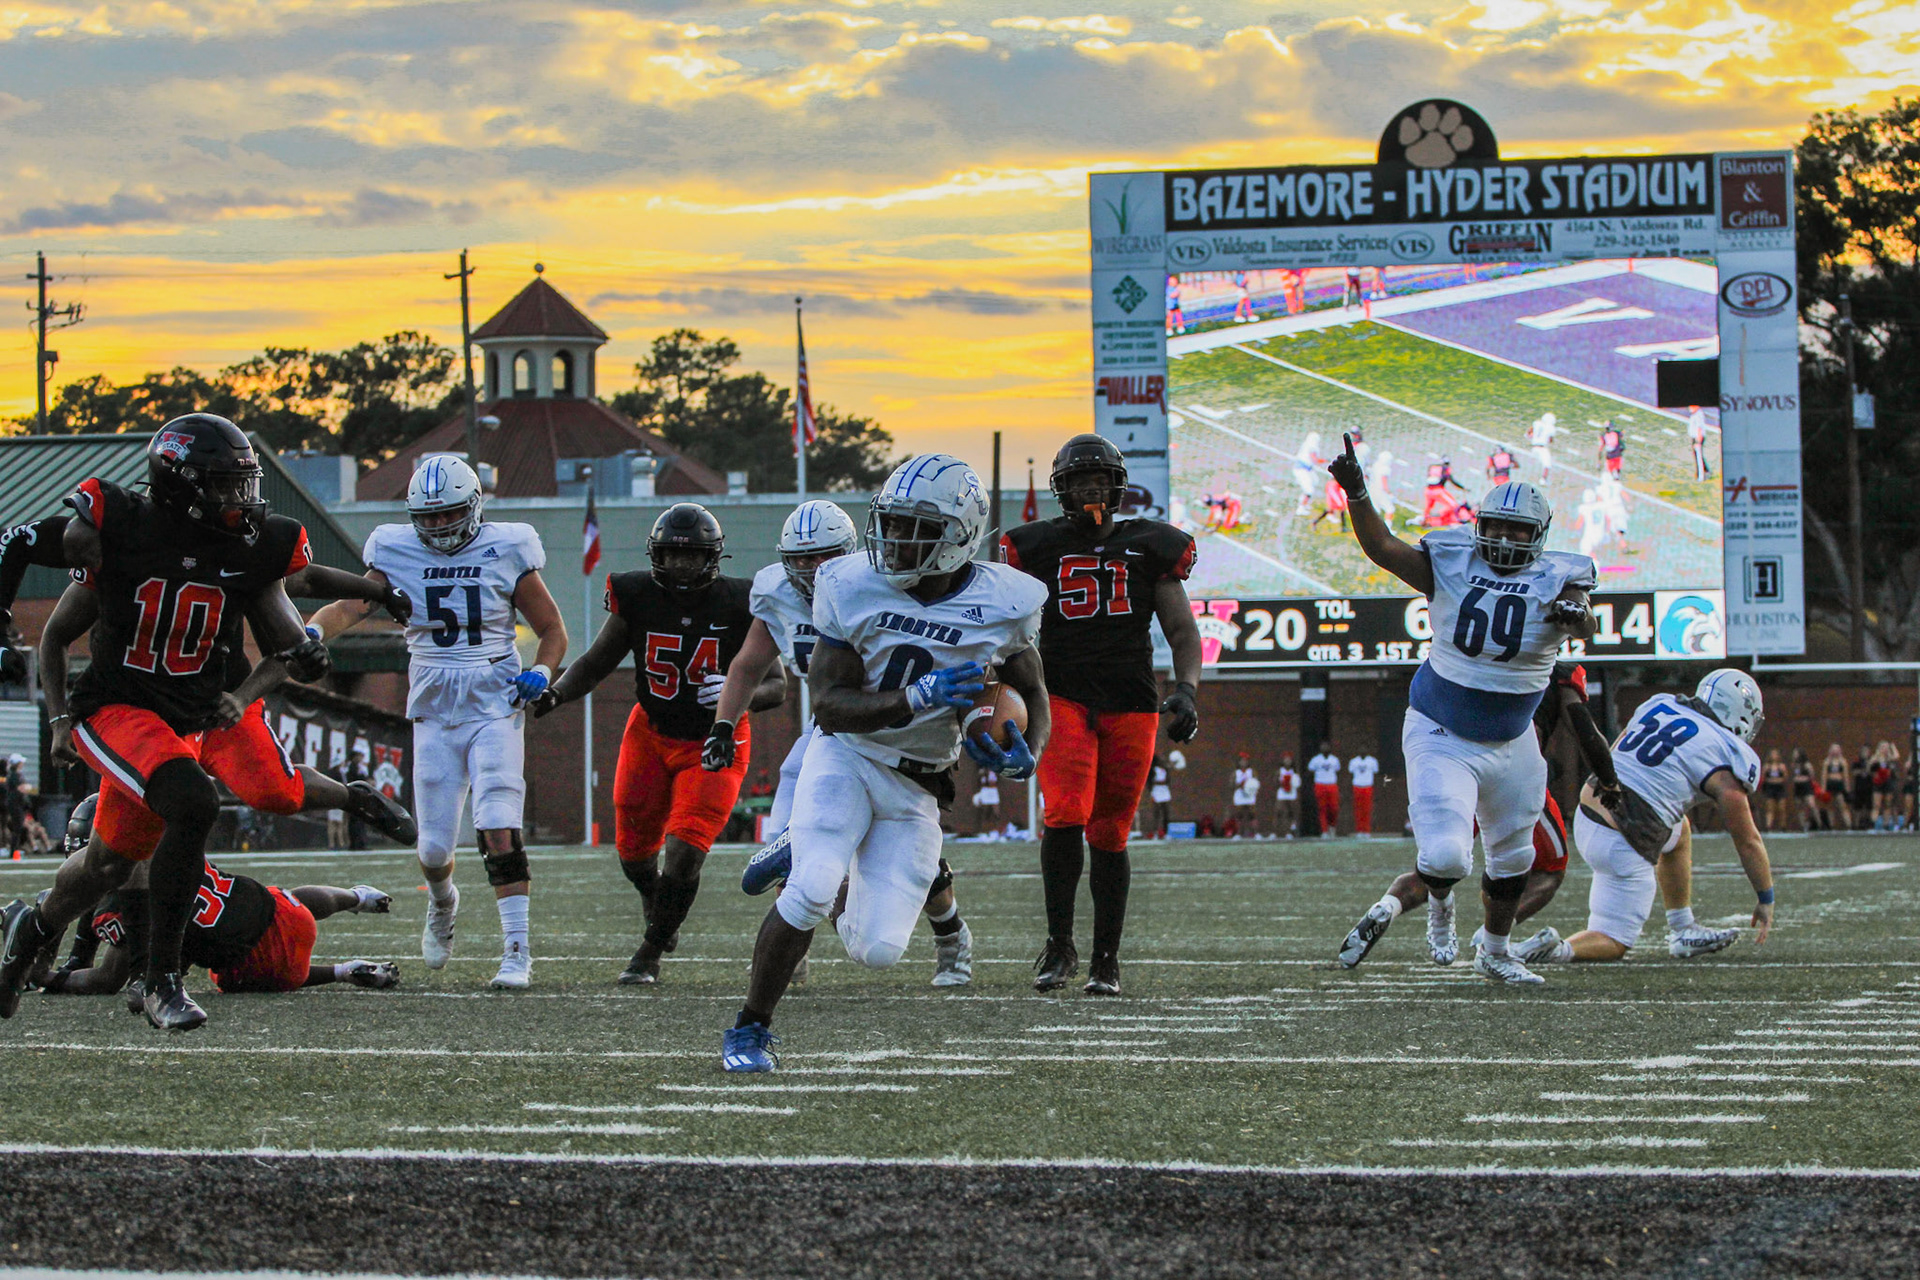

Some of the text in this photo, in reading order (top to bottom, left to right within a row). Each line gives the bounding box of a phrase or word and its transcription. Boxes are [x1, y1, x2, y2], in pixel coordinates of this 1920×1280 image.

[1722, 159, 1784, 175] Blanton
[1172, 171, 1374, 225] BAZEMORE
[1406, 166, 1531, 218] HYDER
[1541, 160, 1706, 213] STADIUM
[1743, 180, 1763, 203] &
[1565, 220, 1595, 232] 4164
[1620, 218, 1679, 231] Valdosta
[1683, 217, 1706, 230] Rd.
[1728, 210, 1780, 227] Griffin
[1212, 233, 1388, 254] Valdosta Insurance Services
[1397, 239, 1428, 253] VIS
[1449, 221, 1552, 255] GRIFFIN
[1176, 245, 1205, 259] VIS
[1098, 374, 1167, 416] WALLER
[1720, 393, 1797, 413] SYNOVUS
[422, 566, 482, 580] SHORTER
[1057, 554, 1133, 620] 51
[1469, 575, 1531, 595] SHORTER
[425, 585, 483, 647] 51
[961, 612, 985, 625] adidas
[1314, 600, 1356, 619] TOL
[1404, 597, 1433, 641] 6
[123, 577, 226, 676] 10
[876, 611, 962, 646] SHORTER
[1244, 609, 1307, 651] 20
[1453, 587, 1527, 663] 69
[1592, 602, 1653, 645] 14
[1307, 642, 1363, 661] QTR 3
[1375, 641, 1413, 661] 1ST
[1561, 638, 1586, 657] 12
[645, 631, 720, 700] 54
[1617, 702, 1699, 768] 58
